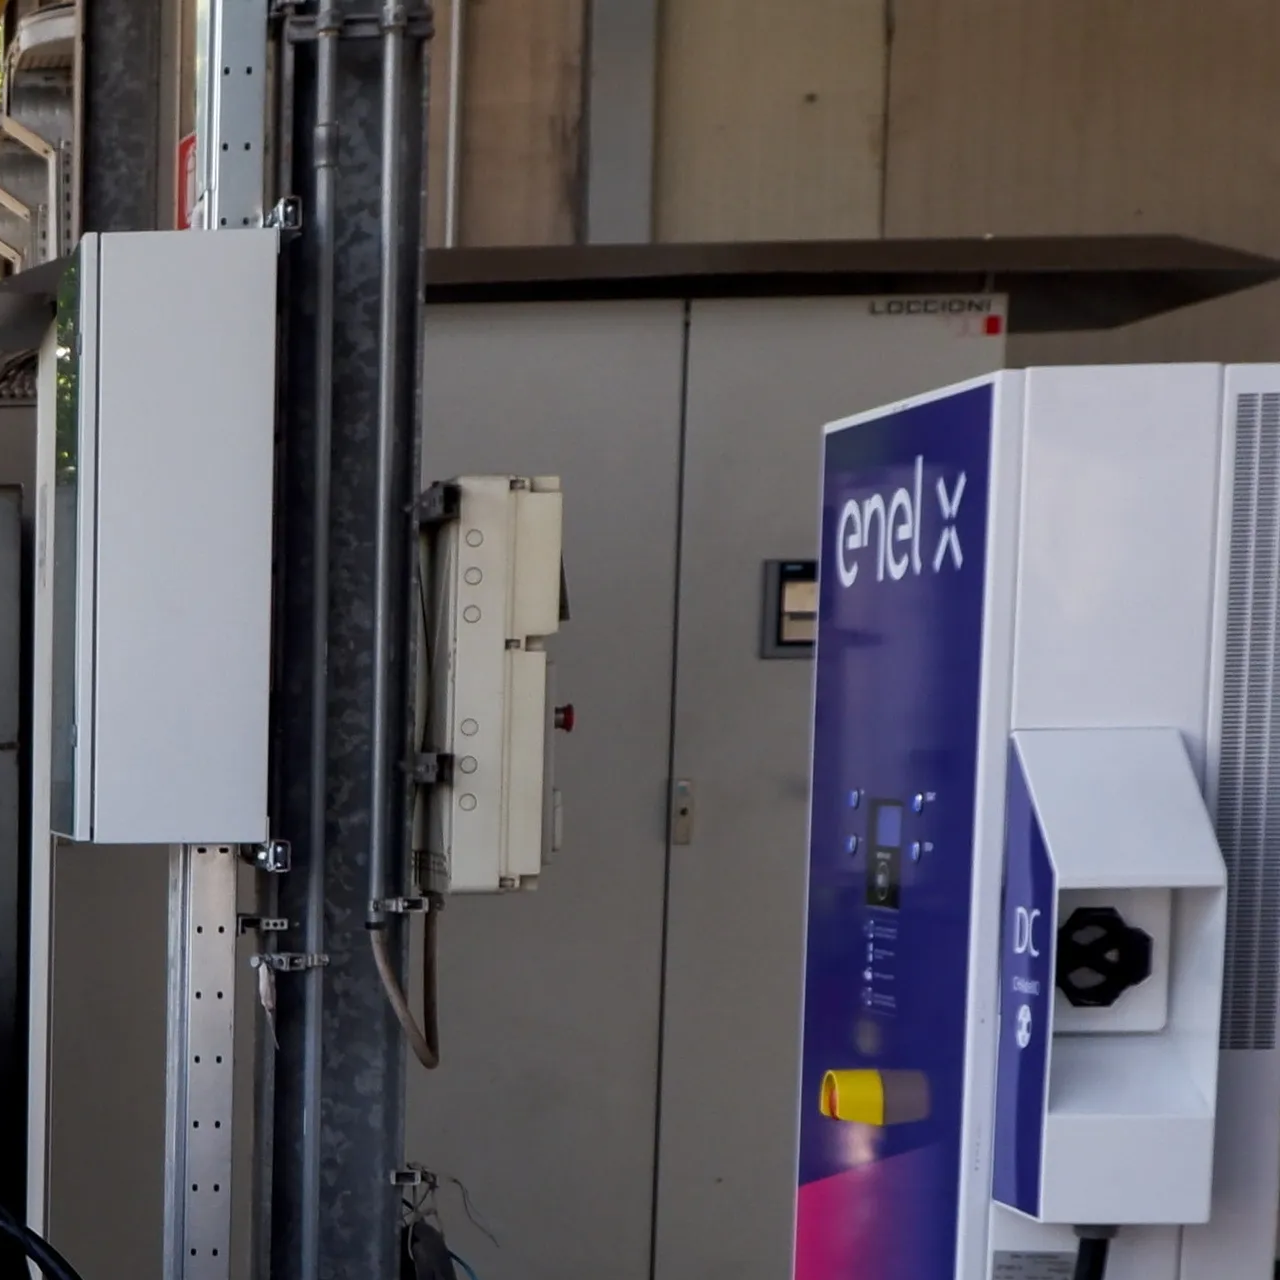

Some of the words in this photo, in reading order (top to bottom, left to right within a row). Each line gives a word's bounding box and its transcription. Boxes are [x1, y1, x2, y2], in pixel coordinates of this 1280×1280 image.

[837, 455, 924, 588] enel
[933, 471, 967, 573] x
[1014, 906, 1041, 958] DC
